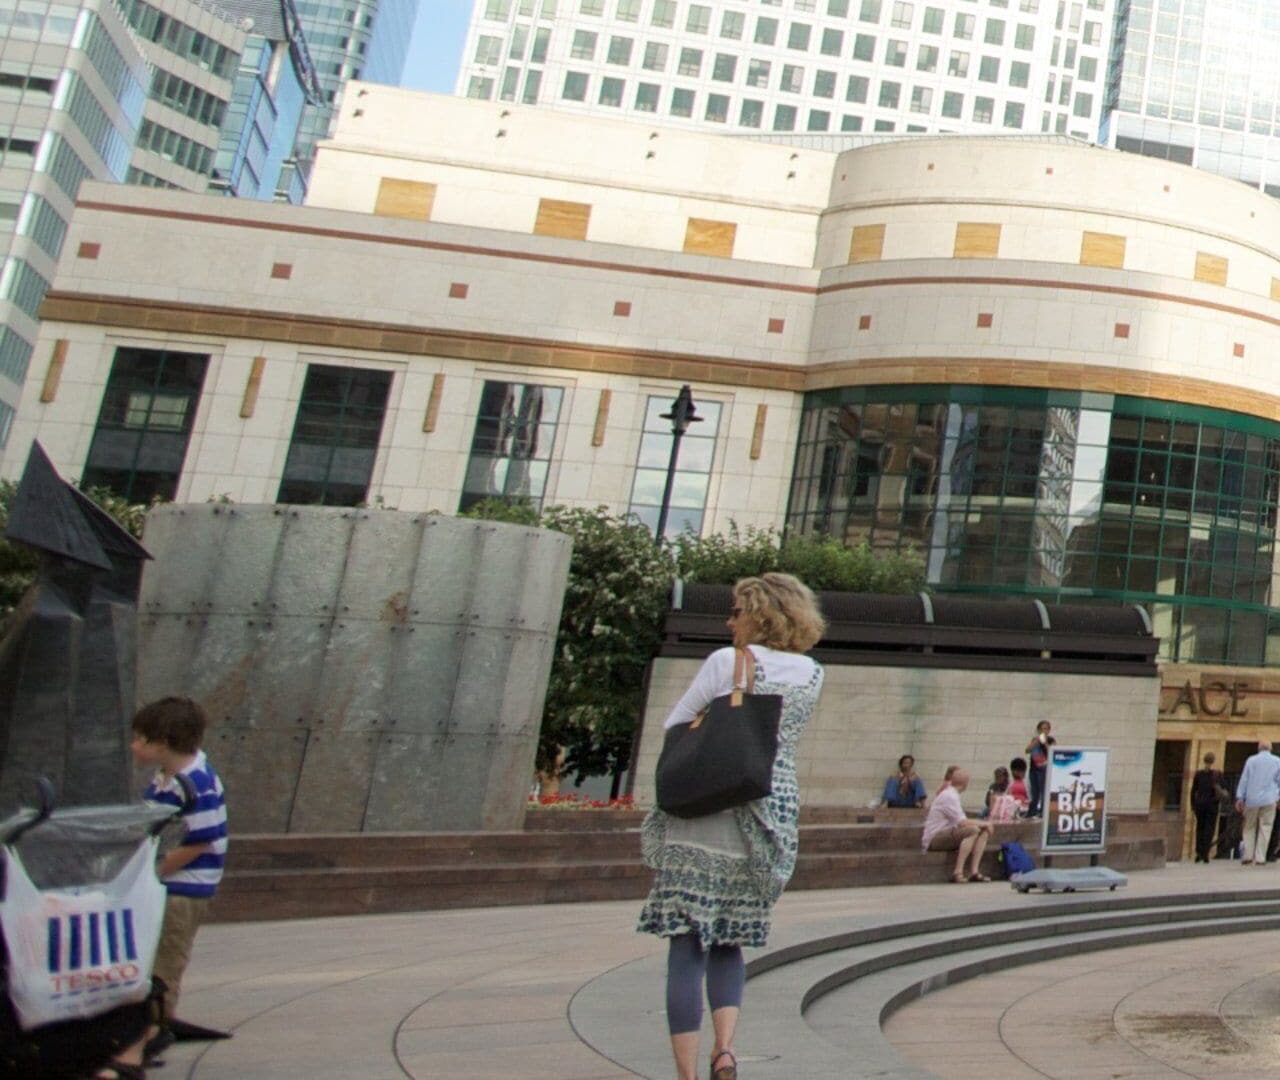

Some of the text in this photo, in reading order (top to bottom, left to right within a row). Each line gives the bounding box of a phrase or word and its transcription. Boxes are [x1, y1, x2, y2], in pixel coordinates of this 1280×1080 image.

[1057, 787, 1097, 812] BIG
[1057, 812, 1095, 832] DIG
[48, 963, 139, 993] TESCO
